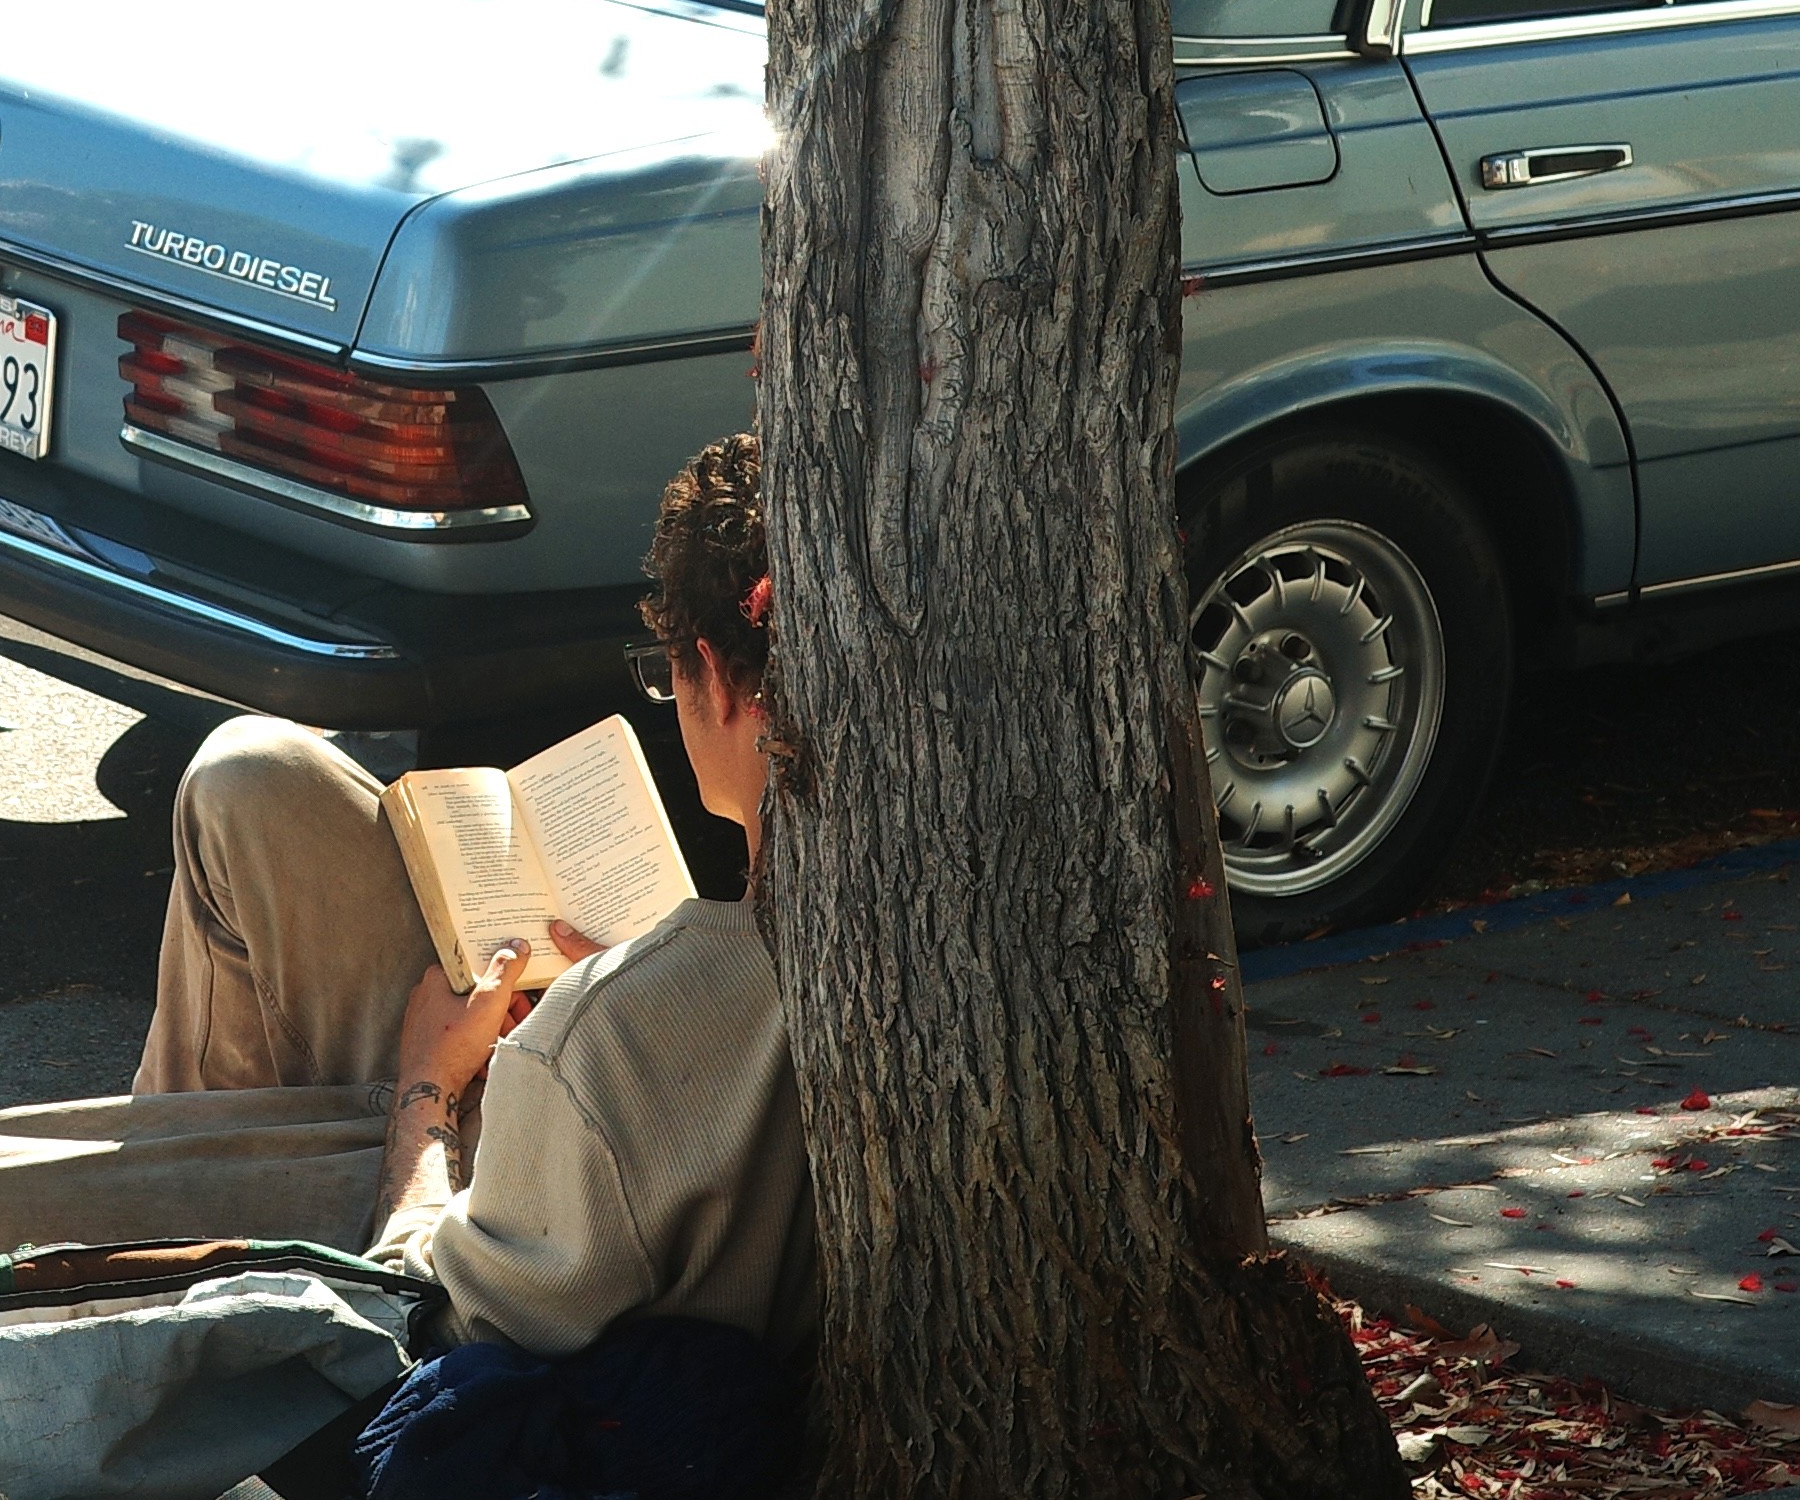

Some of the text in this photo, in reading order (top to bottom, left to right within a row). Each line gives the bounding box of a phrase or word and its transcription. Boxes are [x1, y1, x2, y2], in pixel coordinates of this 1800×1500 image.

[130, 219, 337, 304] TURBO DIESEL
[0, 427, 33, 452] REY
